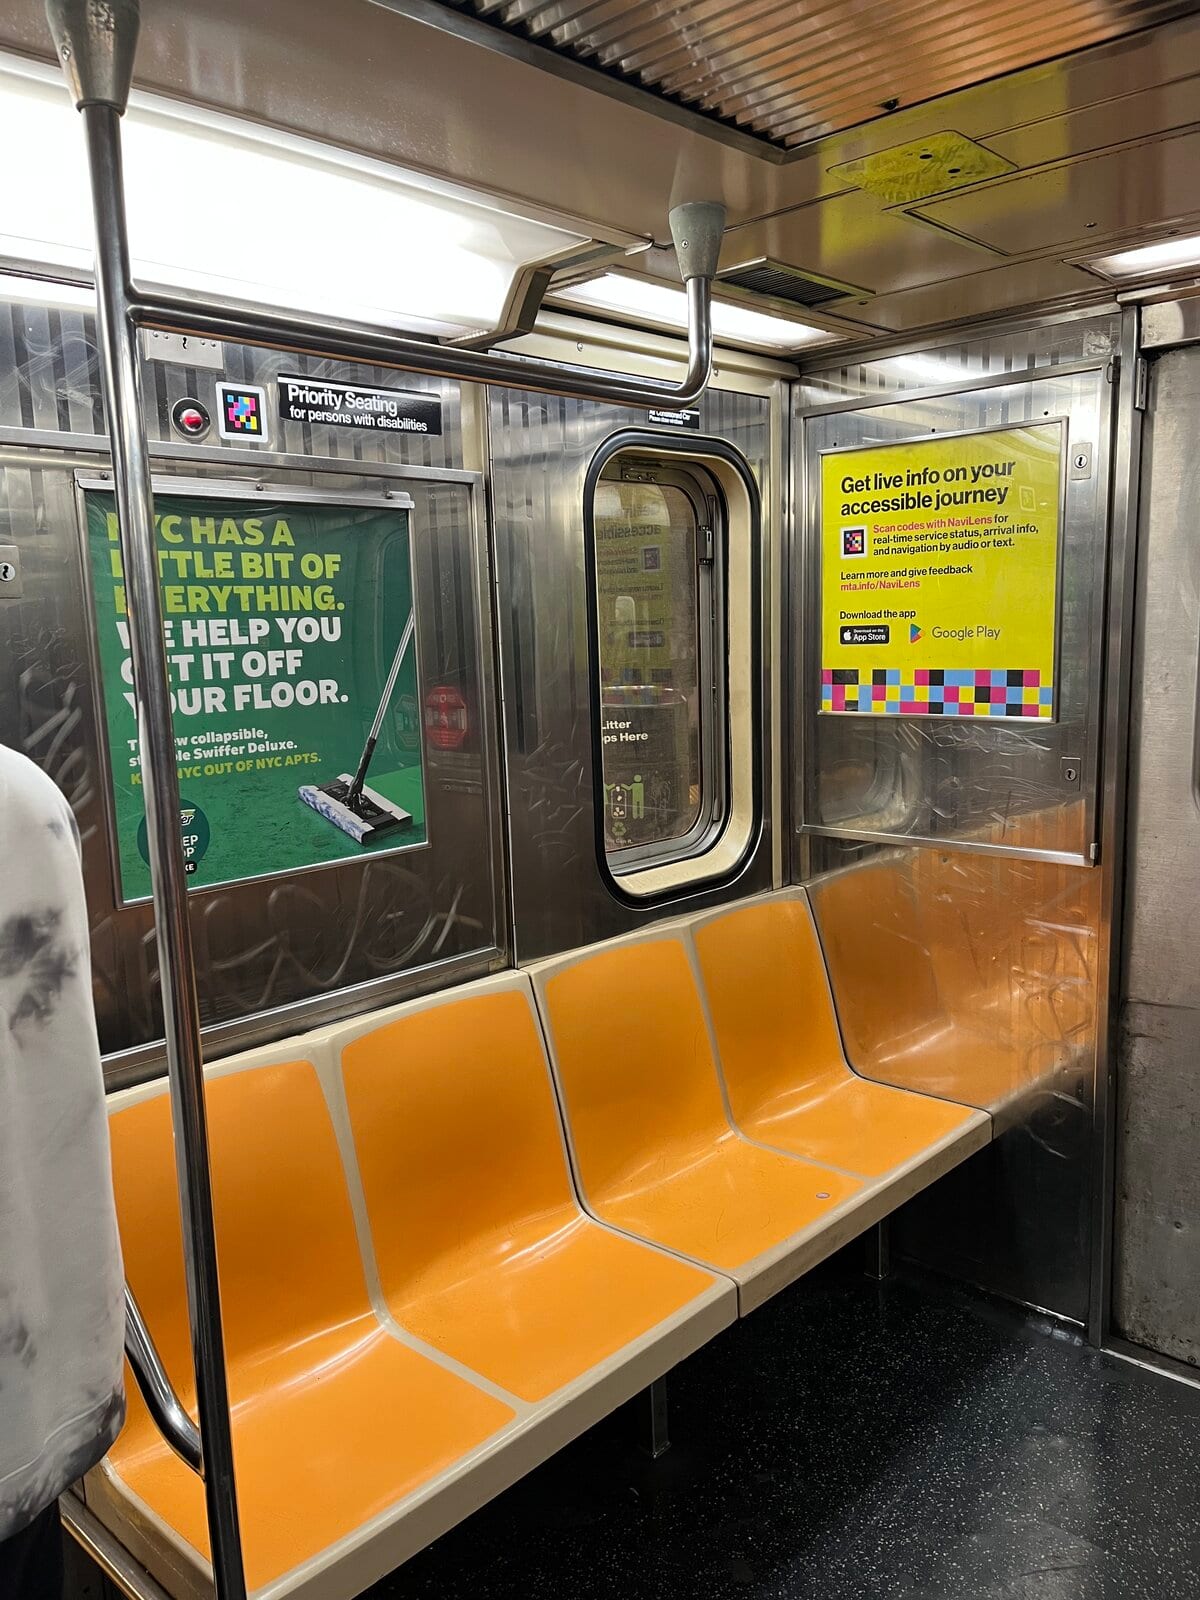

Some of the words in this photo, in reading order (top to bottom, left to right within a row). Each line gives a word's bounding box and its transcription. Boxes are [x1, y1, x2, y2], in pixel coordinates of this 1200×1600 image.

[288, 383, 342, 411] Priority
[345, 391, 398, 415] Seating
[289, 404, 306, 419] for
[308, 409, 352, 424] persons
[353, 412, 376, 426] with
[377, 414, 428, 432] disabilities
[841, 476, 871, 494] Get
[873, 472, 903, 490] live
[906, 467, 940, 487] info
[943, 467, 967, 482] on
[970, 460, 1016, 482] your
[841, 492, 932, 516] accessible
[934, 486, 1009, 511] journey
[190, 516, 265, 547] HAS
[271, 520, 295, 546] A
[873, 523, 896, 534] Scan
[897, 520, 925, 532] codes
[925, 518, 947, 530] with
[947, 515, 993, 528] NaviLens
[994, 513, 1009, 524] for
[873, 531, 913, 545] real-time
[914, 530, 948, 542] service
[949, 527, 982, 540] status,
[983, 524, 1015, 537] arrival
[1016, 523, 1039, 535] info,
[873, 544, 890, 556] and
[891, 541, 938, 557] navigation
[939, 541, 952, 554] by
[952, 539, 979, 551] audio
[980, 538, 991, 549] or
[992, 537, 1015, 548] text.
[110, 549, 235, 579] LTLE
[240, 552, 294, 579] BIT
[300, 553, 342, 579] OF
[840, 570, 865, 581] Learn
[866, 569, 889, 579] more
[890, 567, 908, 578] and
[908, 566, 928, 579] give
[928, 564, 973, 576] feedback
[840, 579, 921, 592] mta.info/NaviLens
[114, 585, 345, 614] EERYTHING.
[840, 610, 883, 620] Download
[884, 609, 898, 619] the
[899, 610, 916, 620] app
[182, 618, 270, 648] HELP
[275, 616, 341, 643] YOU
[853, 634, 867, 642] App
[868, 633, 886, 641] Store
[931, 626, 974, 641] Google
[976, 626, 1001, 640] Play
[202, 652, 235, 680] IT
[241, 649, 303, 678] OFF
[123, 687, 227, 719] UR
[233, 679, 349, 712] FLOOR.
[190, 728, 268, 746] collapsible,
[620, 732, 648, 741] Here
[193, 744, 245, 760] Swiffer
[248, 739, 298, 754] Deluxe.
[204, 762, 233, 776] OUT
[236, 760, 253, 773] OF
[256, 756, 283, 770] NYC
[284, 752, 321, 767] APTS.
